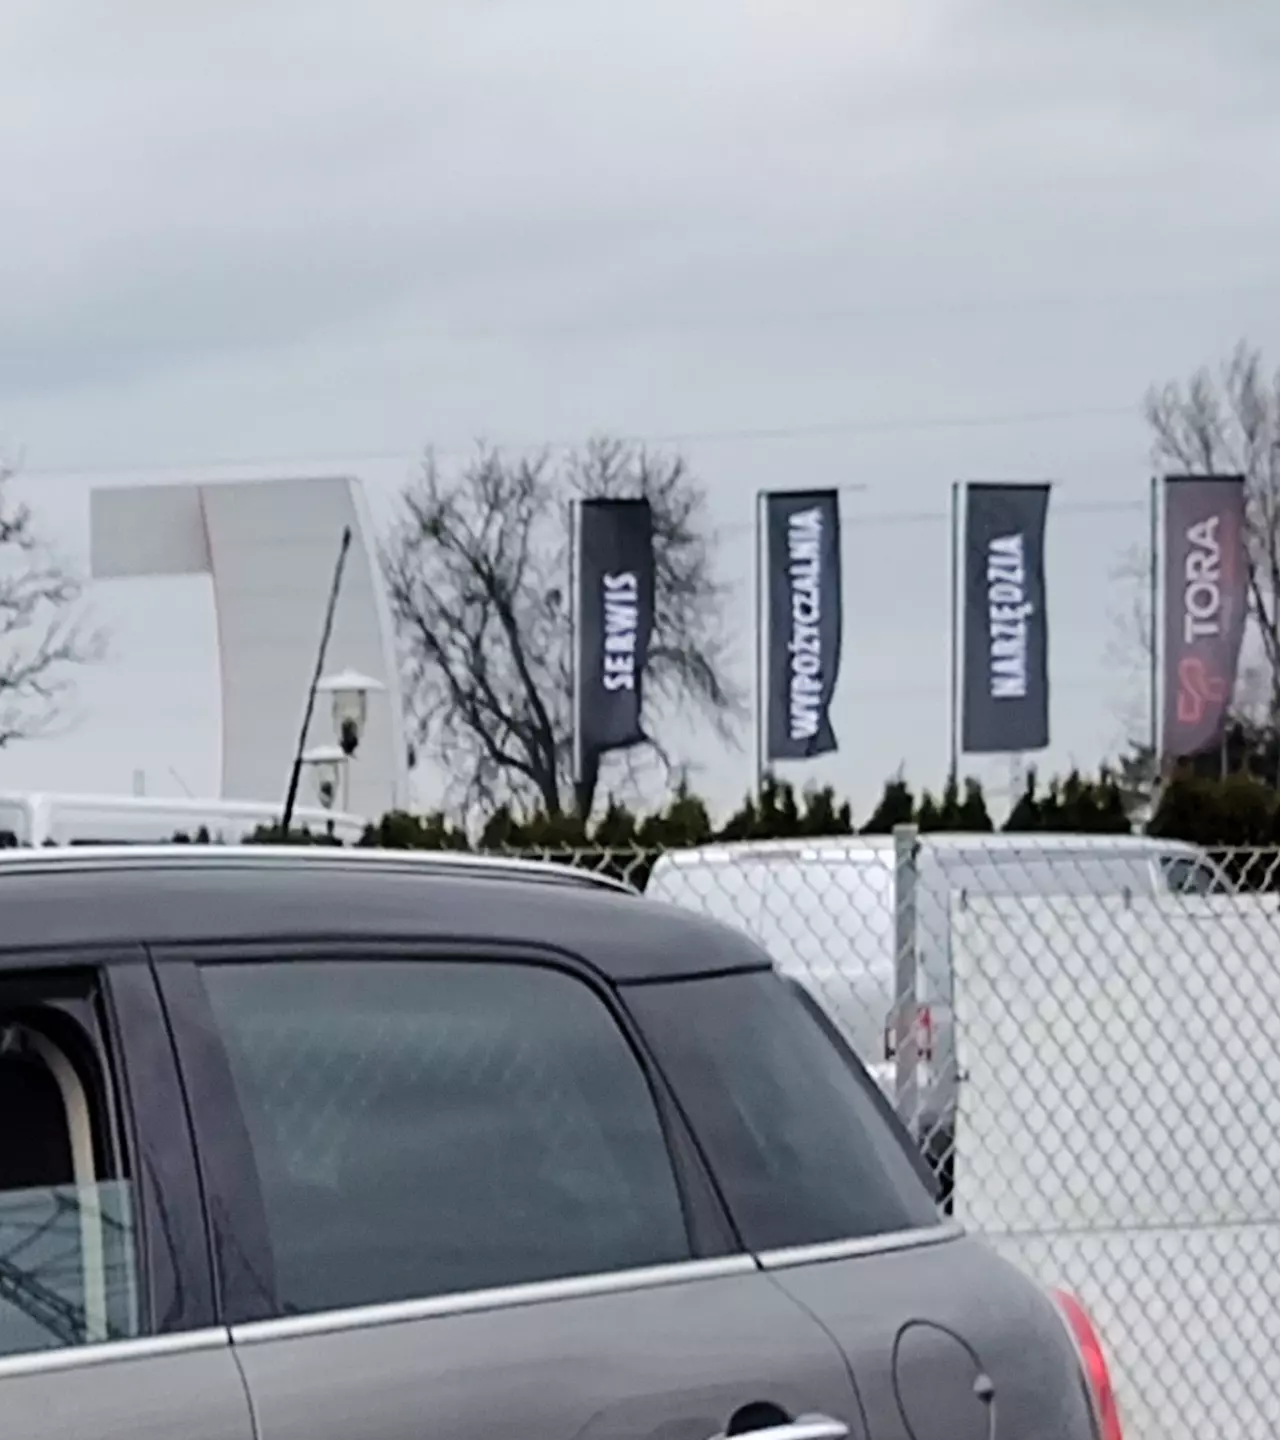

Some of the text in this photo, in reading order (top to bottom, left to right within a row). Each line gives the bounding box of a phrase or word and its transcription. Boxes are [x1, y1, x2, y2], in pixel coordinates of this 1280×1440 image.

[602, 571, 639, 691] SERWIS
[787, 507, 824, 740] WYPOŻYCZALNIA
[986, 533, 1033, 698] NARZĘDZIA
[1183, 515, 1221, 643] TORA
